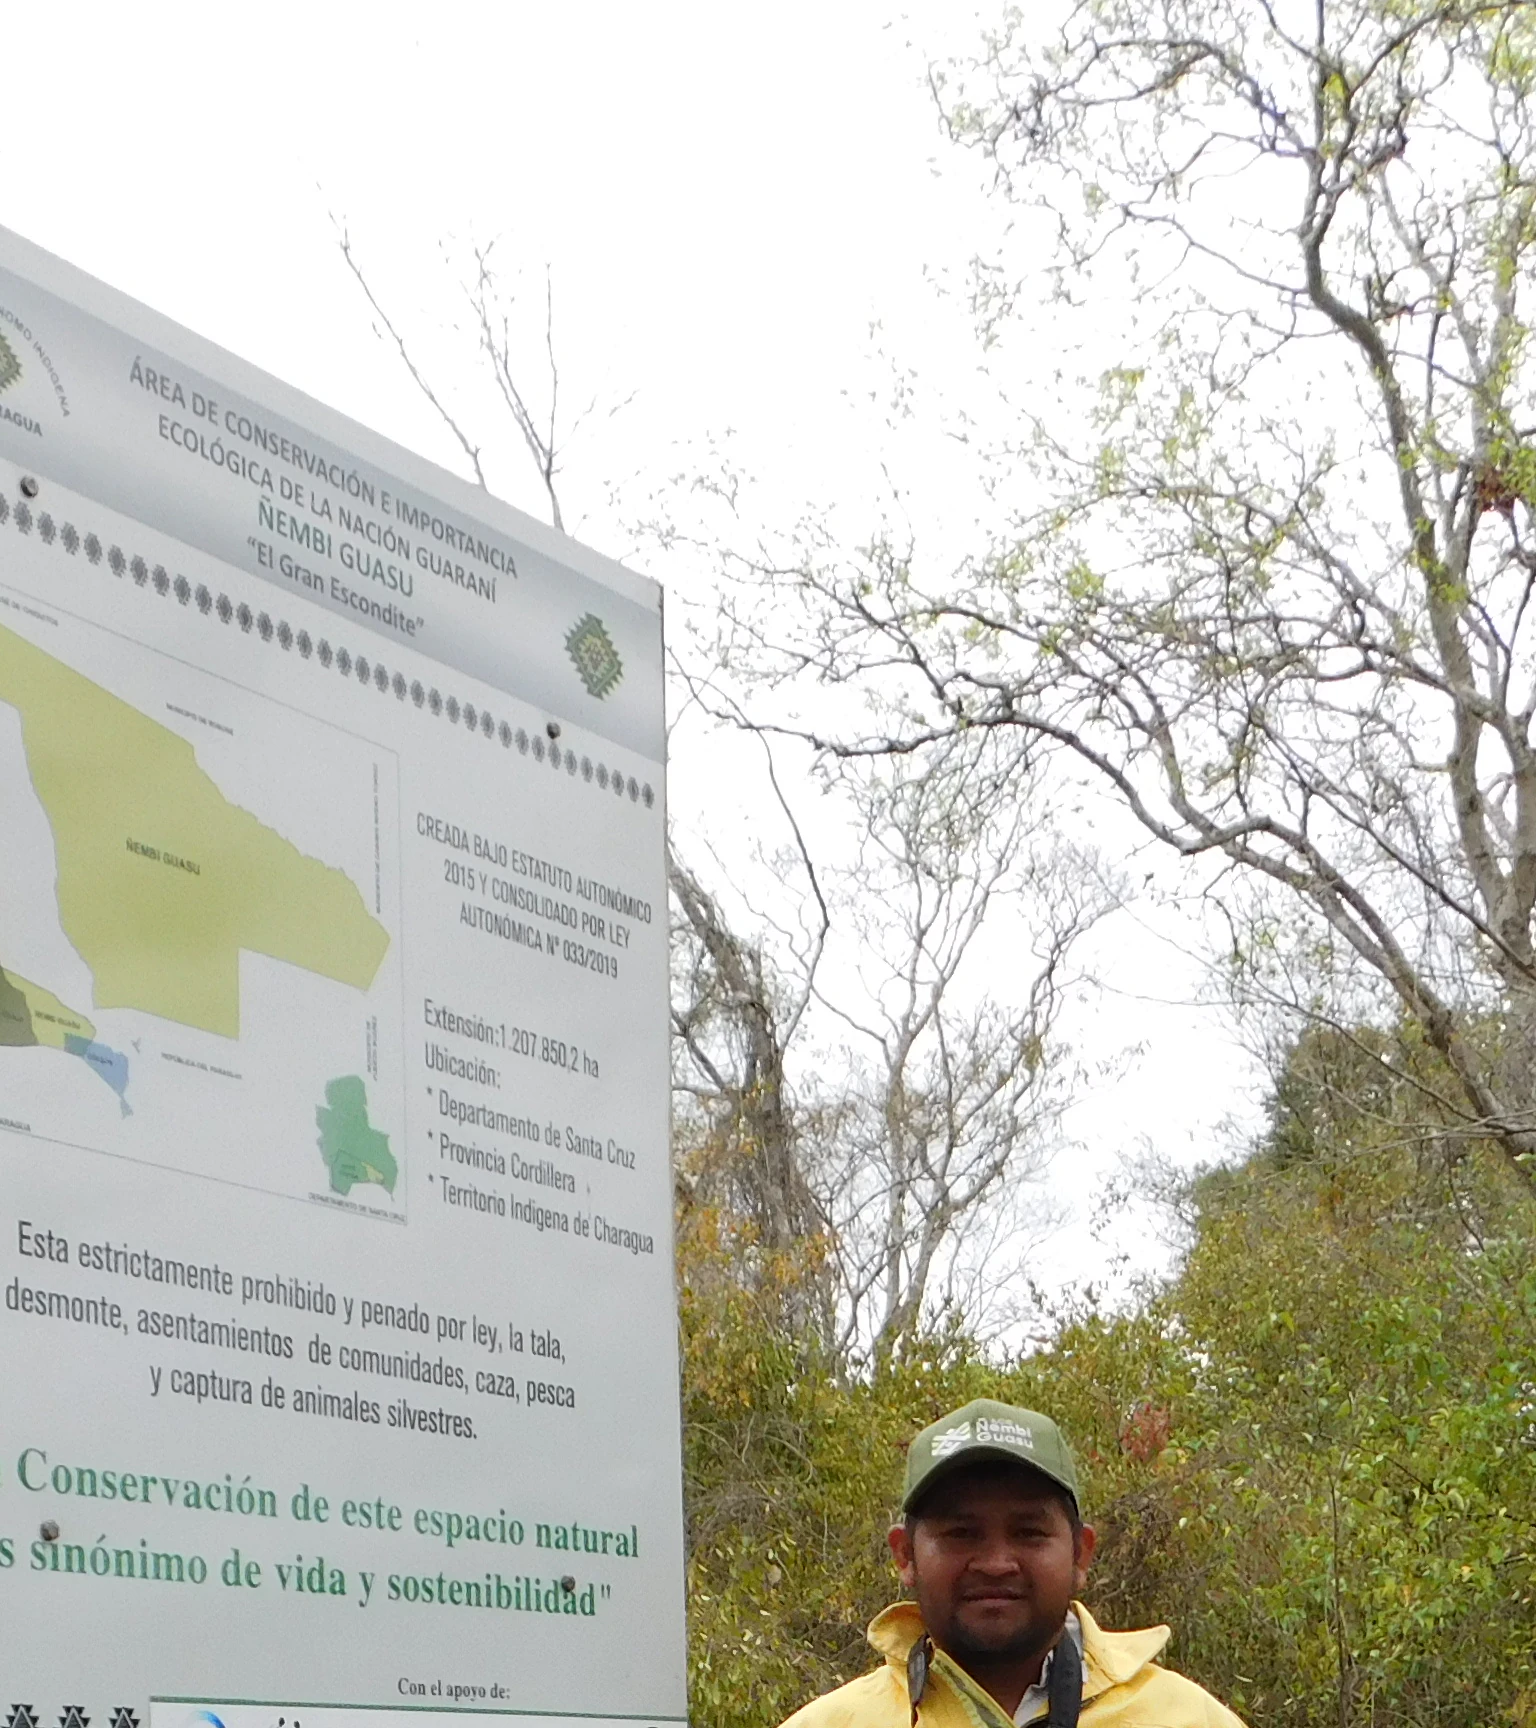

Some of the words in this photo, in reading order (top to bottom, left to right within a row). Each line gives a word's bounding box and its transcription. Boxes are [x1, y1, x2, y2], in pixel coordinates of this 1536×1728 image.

[130, 355, 186, 410] ÁREA
[192, 391, 218, 426] DE
[225, 410, 375, 507] CONSERVACIÓN
[381, 490, 391, 515] E
[395, 498, 517, 579] IMPORTANCIA
[158, 414, 274, 493] ECOLÓGICA
[280, 475, 305, 508] DE
[310, 491, 333, 524] LA
[338, 506, 410, 561] NACIÓN
[415, 546, 497, 604] GUARANÍ
[258, 494, 332, 560] ÑEMBI
[339, 542, 413, 598] GUASU
[279, 554, 324, 594] Gran
[331, 576, 424, 637] Escondite”
[126, 837, 160, 862] ÑEMBI
[163, 851, 201, 876] GUASU
[416, 812, 470, 854] CREADA
[473, 833, 507, 868] BAJO
[512, 849, 572, 894] ESTATUTO
[576, 876, 652, 925] AUTONÓMICO
[444, 858, 475, 892] 2015
[479, 873, 488, 896] Y
[491, 877, 577, 930] CONSOLIDADO
[581, 911, 606, 941] POR
[609, 923, 631, 949] LEY
[459, 901, 543, 952] AUTONÓMICA
[563, 939, 619, 980] 033/2019
[425, 1041, 501, 1089] Ubicación:
[583, 1049, 599, 1079] ha
[439, 1088, 540, 1143] Departamento
[544, 1120, 561, 1149] de
[565, 1125, 603, 1161] Santa
[607, 1138, 636, 1170] Cruz
[440, 1132, 506, 1176] Provincia
[511, 1152, 576, 1193] Cordillera
[440, 1175, 506, 1217] Territorio
[573, 1210, 589, 1237] de
[594, 1214, 654, 1256] Charagua
[17, 1219, 69, 1265] Esta
[78, 1241, 234, 1297] estrictamente
[241, 1273, 337, 1317] prohibido
[343, 1295, 354, 1325] y
[361, 1299, 430, 1335] penado
[437, 1315, 467, 1343] por
[472, 1314, 504, 1354] ley,
[509, 1321, 524, 1353] la
[530, 1329, 566, 1365] tala,
[5, 1276, 129, 1336] desmonte,
[137, 1307, 294, 1360] asentamientos
[308, 1333, 332, 1366] de
[339, 1345, 470, 1395] comunidades,
[475, 1370, 520, 1401] caza,
[527, 1378, 576, 1408] pesca
[149, 1365, 162, 1397] y
[171, 1367, 253, 1405] captura
[261, 1376, 285, 1410] de
[292, 1384, 381, 1425] animales
[387, 1398, 478, 1440] silvestres.
[976, 1431, 1034, 1449] Guasu
[17, 1448, 279, 1518] Conservación
[290, 1482, 330, 1523] de
[341, 1496, 403, 1532] este
[413, 1507, 525, 1548] espacio
[535, 1520, 639, 1558] natural
[29, 1533, 208, 1585] sinónimo
[221, 1547, 262, 1589] de
[275, 1554, 347, 1596] vida
[358, 1571, 376, 1608] y
[398, 1677, 426, 1697] Con
[430, 1679, 442, 1697] el
[446, 1683, 486, 1702] apoyo
[489, 1682, 511, 1700] de:
